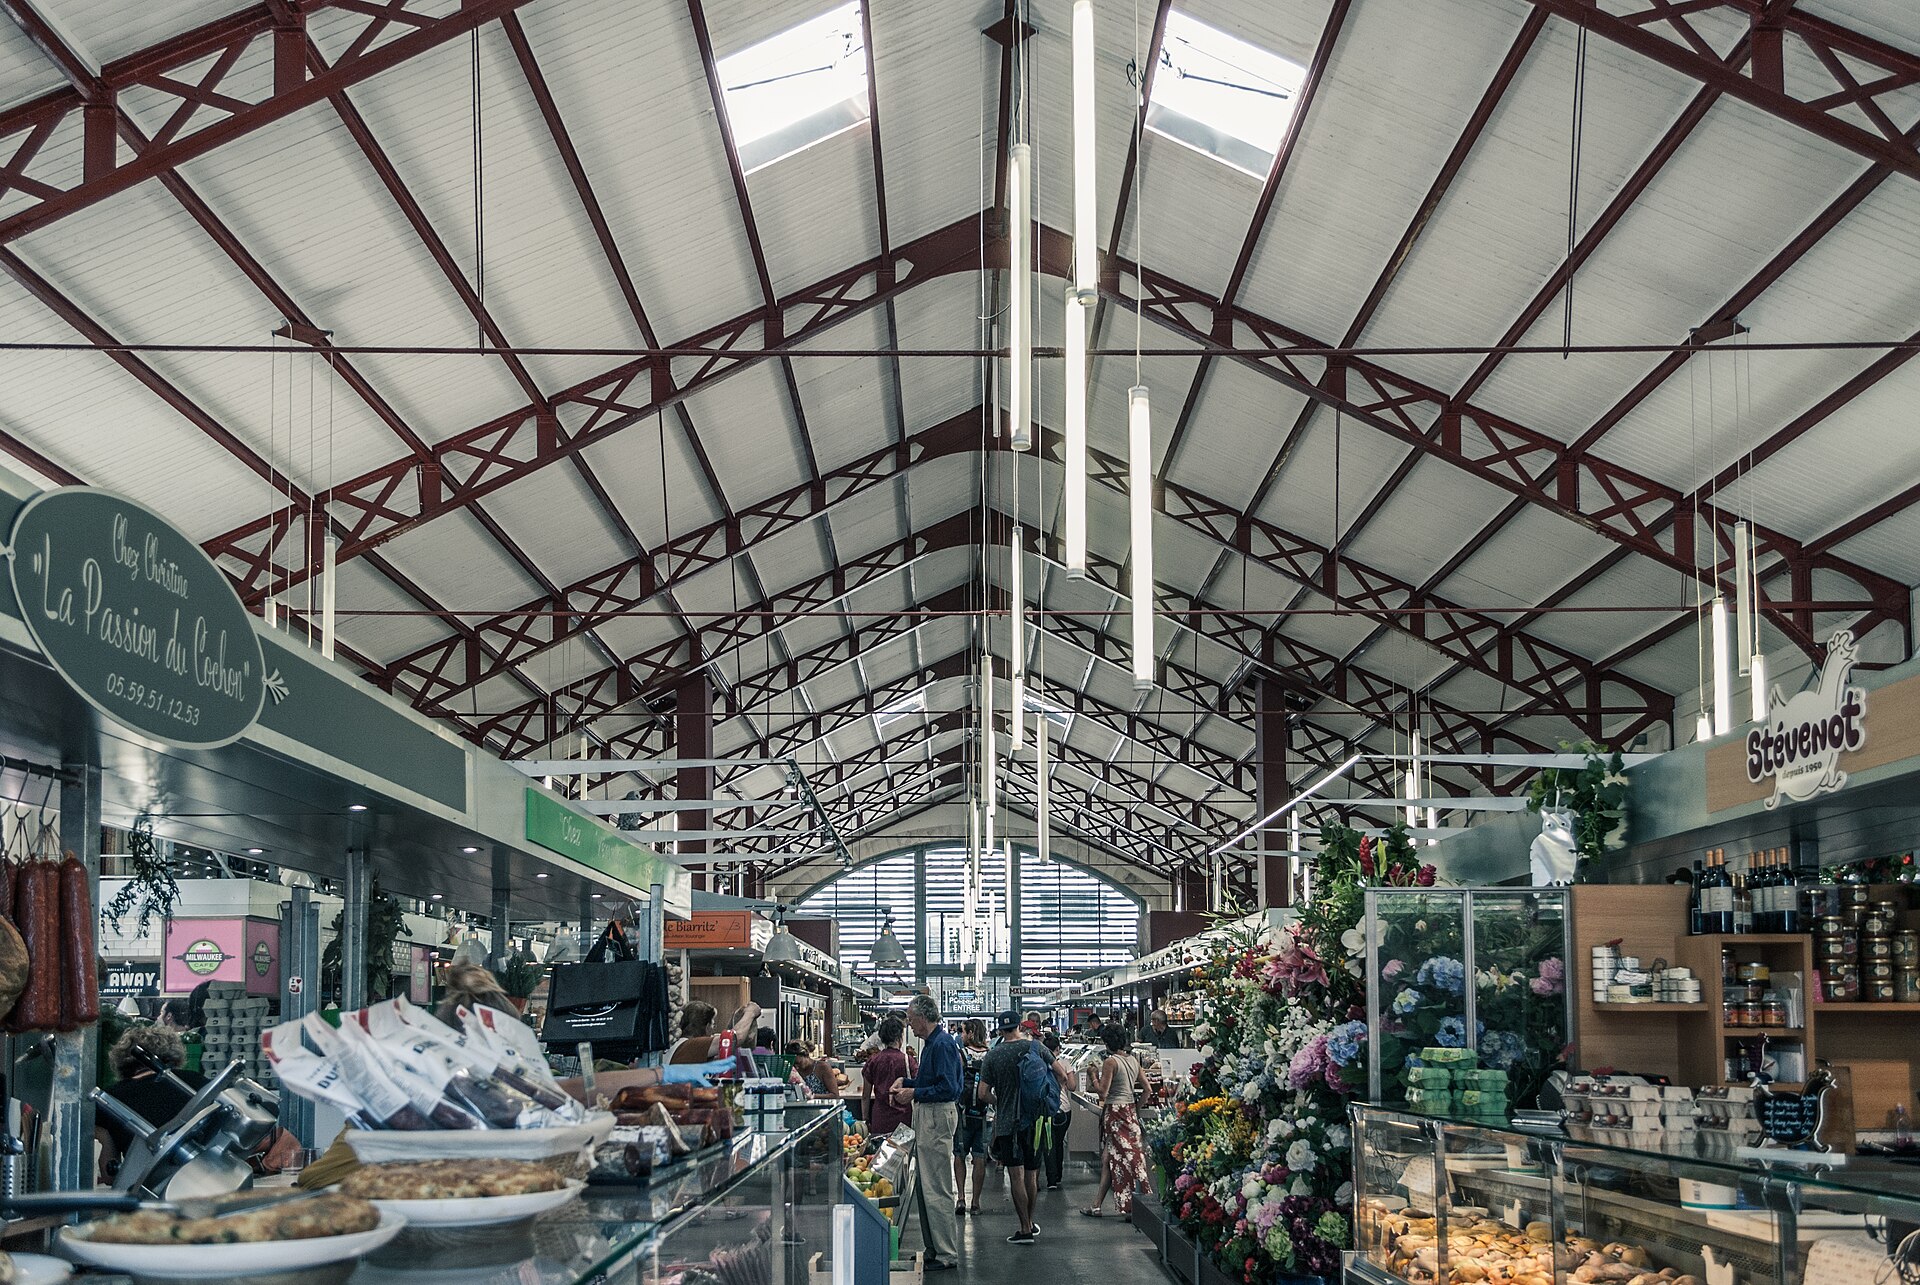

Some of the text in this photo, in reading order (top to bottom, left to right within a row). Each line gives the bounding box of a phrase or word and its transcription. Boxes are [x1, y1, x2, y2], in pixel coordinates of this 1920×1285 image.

[113, 513, 189, 599] Chez Christine
[82, 557, 160, 663] Passion
[165, 607, 188, 676] du
[106, 672, 201, 726] 05.59.51.12.53
[1781, 761, 1823, 780] depuis 1950
[185, 953, 223, 961] MILWAUKEE
[109, 972, 156, 987] AWAY
